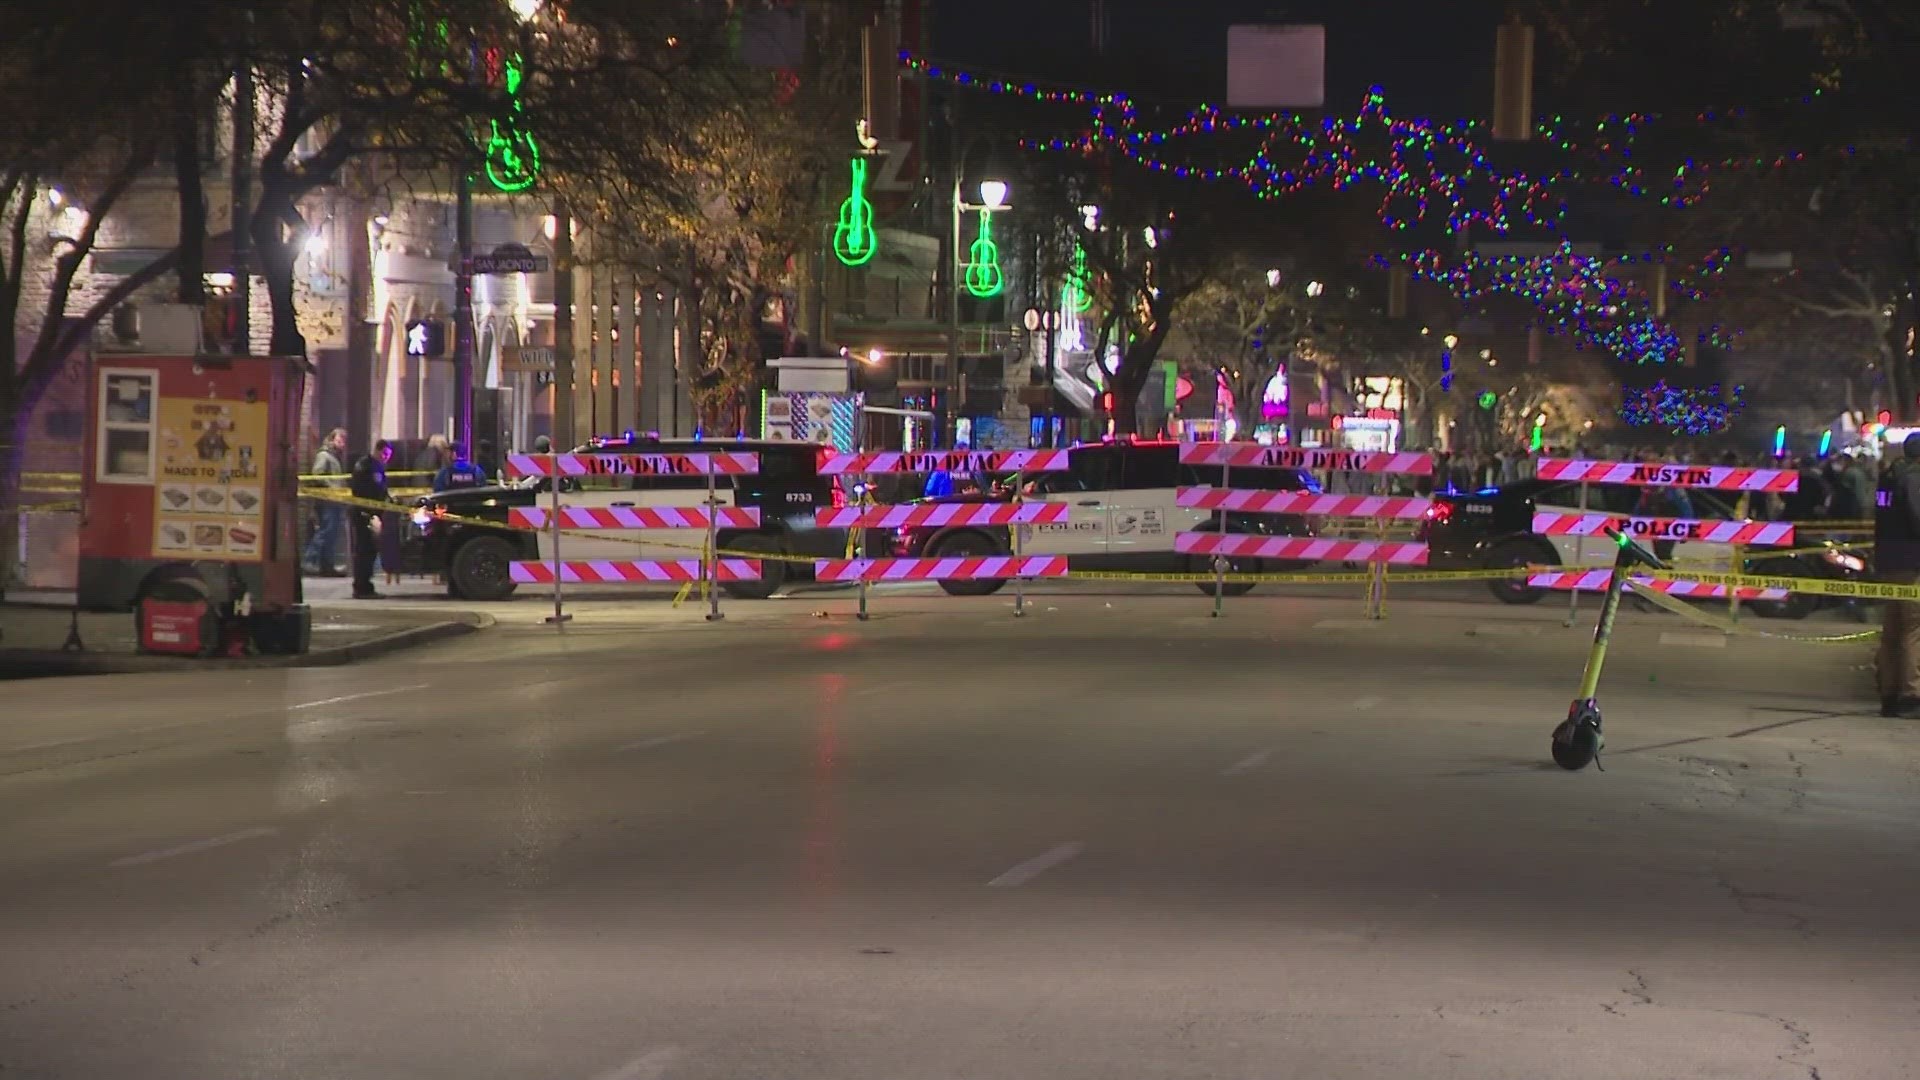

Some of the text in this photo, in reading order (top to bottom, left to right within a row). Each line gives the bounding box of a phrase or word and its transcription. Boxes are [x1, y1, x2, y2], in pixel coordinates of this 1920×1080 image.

[474, 259, 535, 271] SAN JACINTO
[585, 457, 691, 474] APD DTAC
[894, 454, 1001, 471] APD DTAC
[1261, 449, 1367, 470] APD DTAC
[164, 466, 198, 476] MADE
[201, 467, 215, 477] TO
[1630, 466, 1711, 484] AUSTIN
[785, 492, 812, 502] 8733
[1038, 522, 1102, 534] POLICE
[1618, 520, 1702, 538] POLICE
